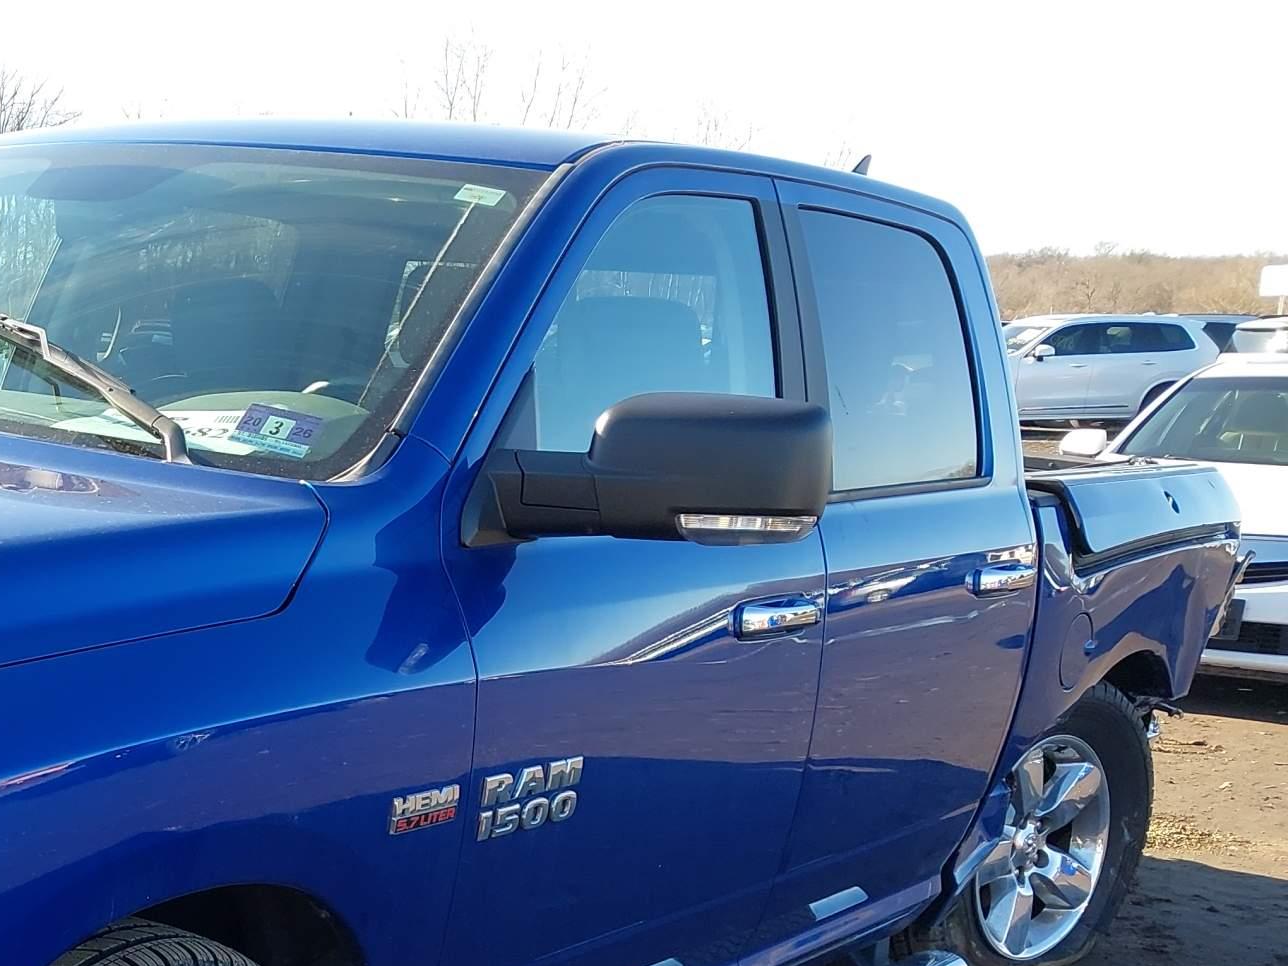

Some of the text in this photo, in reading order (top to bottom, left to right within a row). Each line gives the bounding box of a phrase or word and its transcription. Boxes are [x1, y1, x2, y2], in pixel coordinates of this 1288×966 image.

[243, 415, 262, 426] 20
[269, 420, 284, 435] 3
[292, 427, 313, 439] 26
[482, 756, 584, 806] RAM
[394, 784, 460, 816] HEMI
[476, 790, 577, 841] 1500
[397, 807, 456, 831] 5.7 LITER
